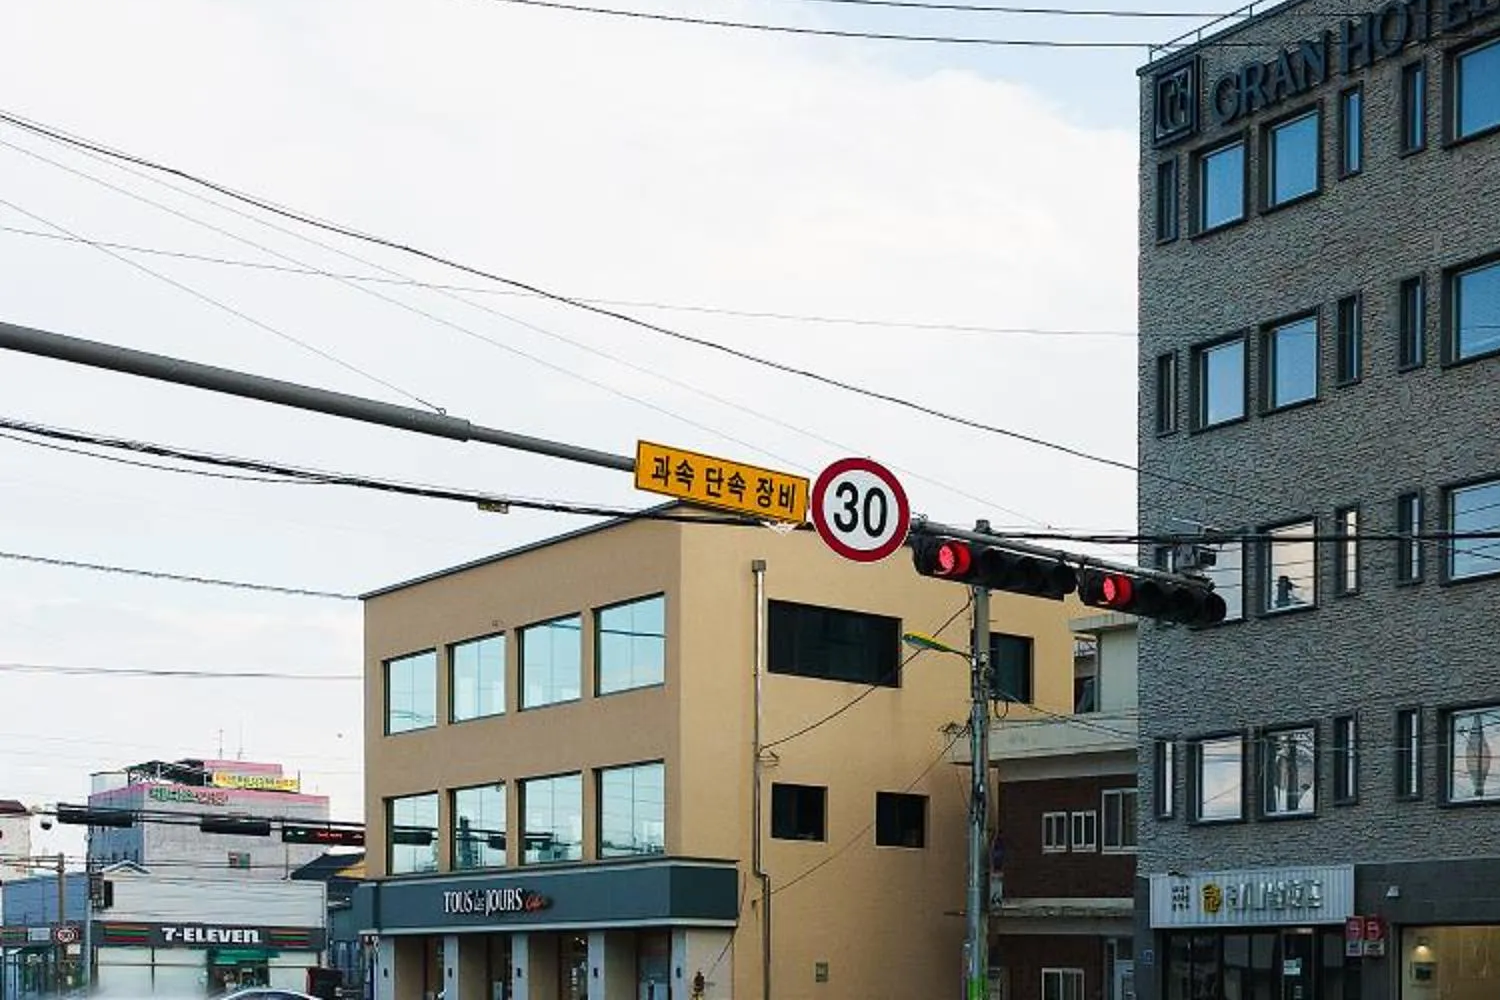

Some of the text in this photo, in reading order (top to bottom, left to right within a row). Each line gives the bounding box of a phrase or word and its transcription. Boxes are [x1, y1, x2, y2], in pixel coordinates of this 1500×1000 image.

[1210, 30, 1331, 126] GRAN
[651, 454, 796, 514] 과속 단속 장비
[834, 481, 887, 538] 30
[485, 887, 525, 917] JOURS
